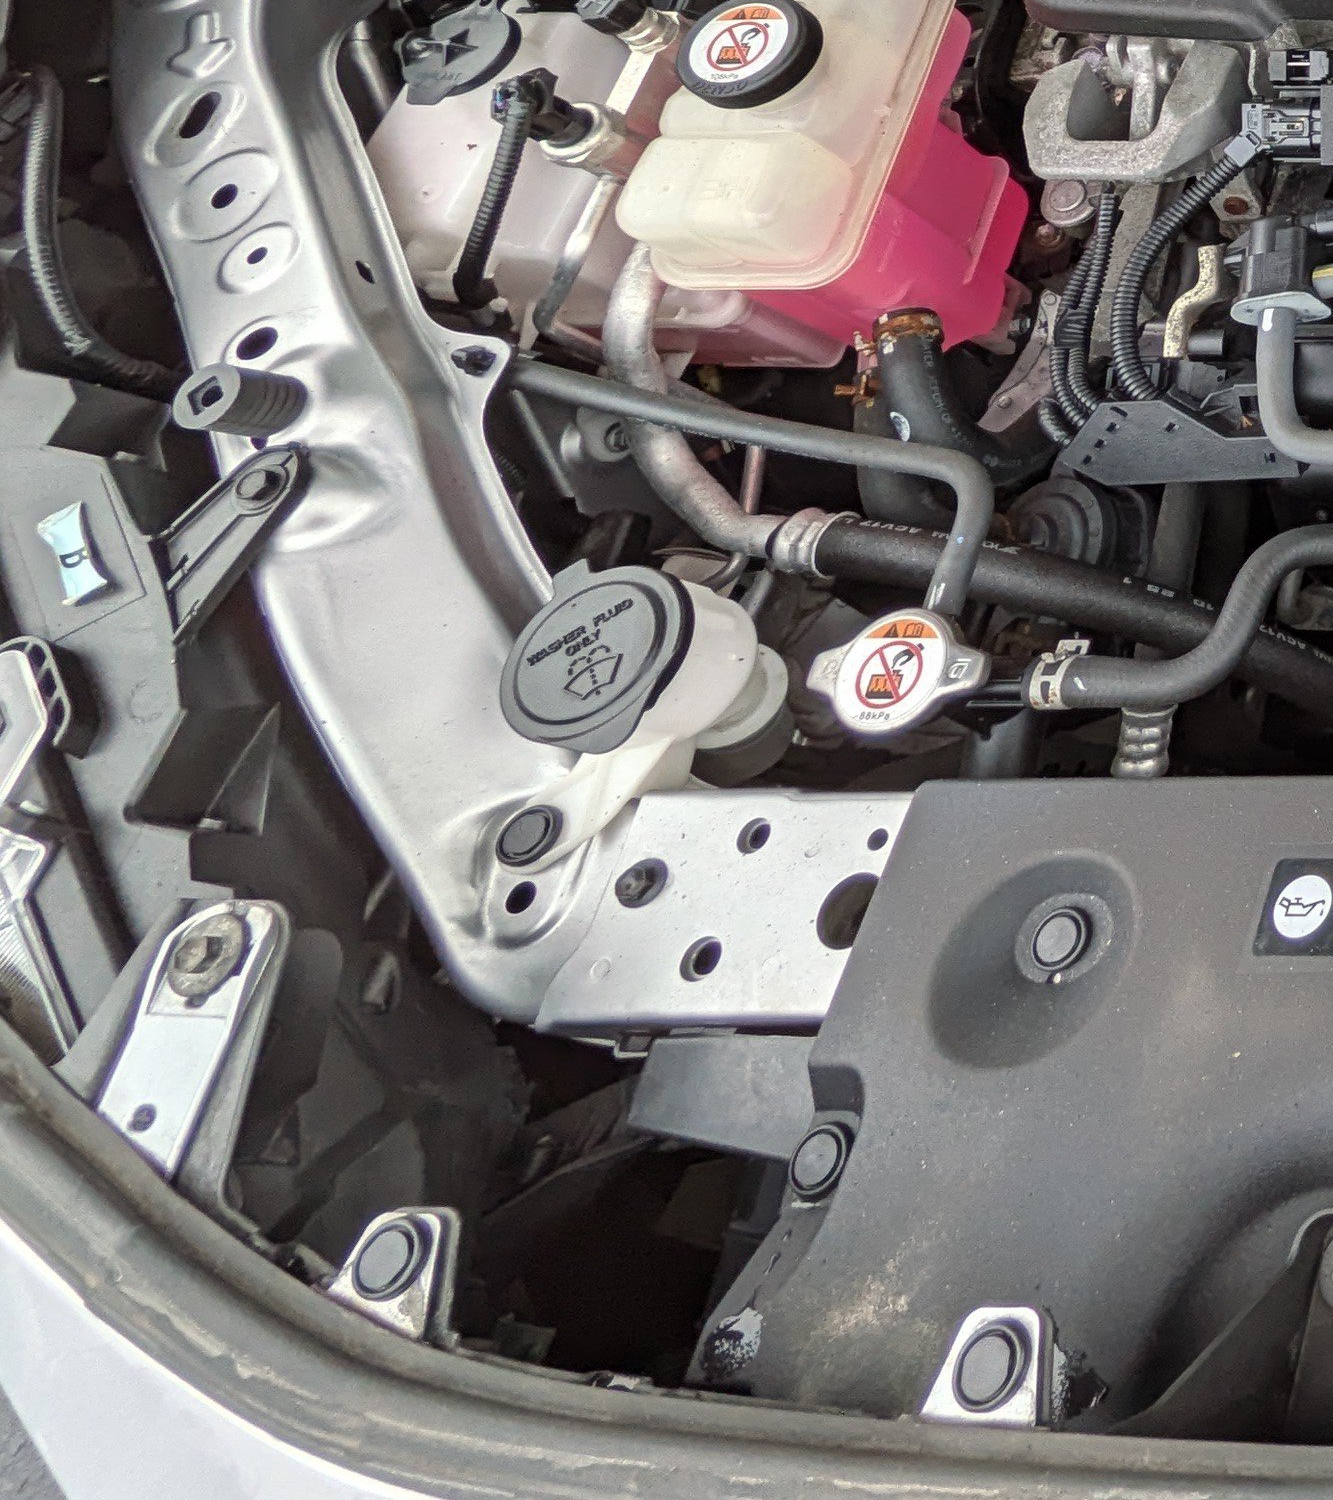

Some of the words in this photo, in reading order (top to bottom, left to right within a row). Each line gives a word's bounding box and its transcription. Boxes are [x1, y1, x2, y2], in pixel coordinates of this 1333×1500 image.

[526, 625, 587, 667] WASHER
[592, 598, 634, 627] FLUID
[565, 628, 601, 657] ONLY
[858, 711, 891, 721] 88kPa
